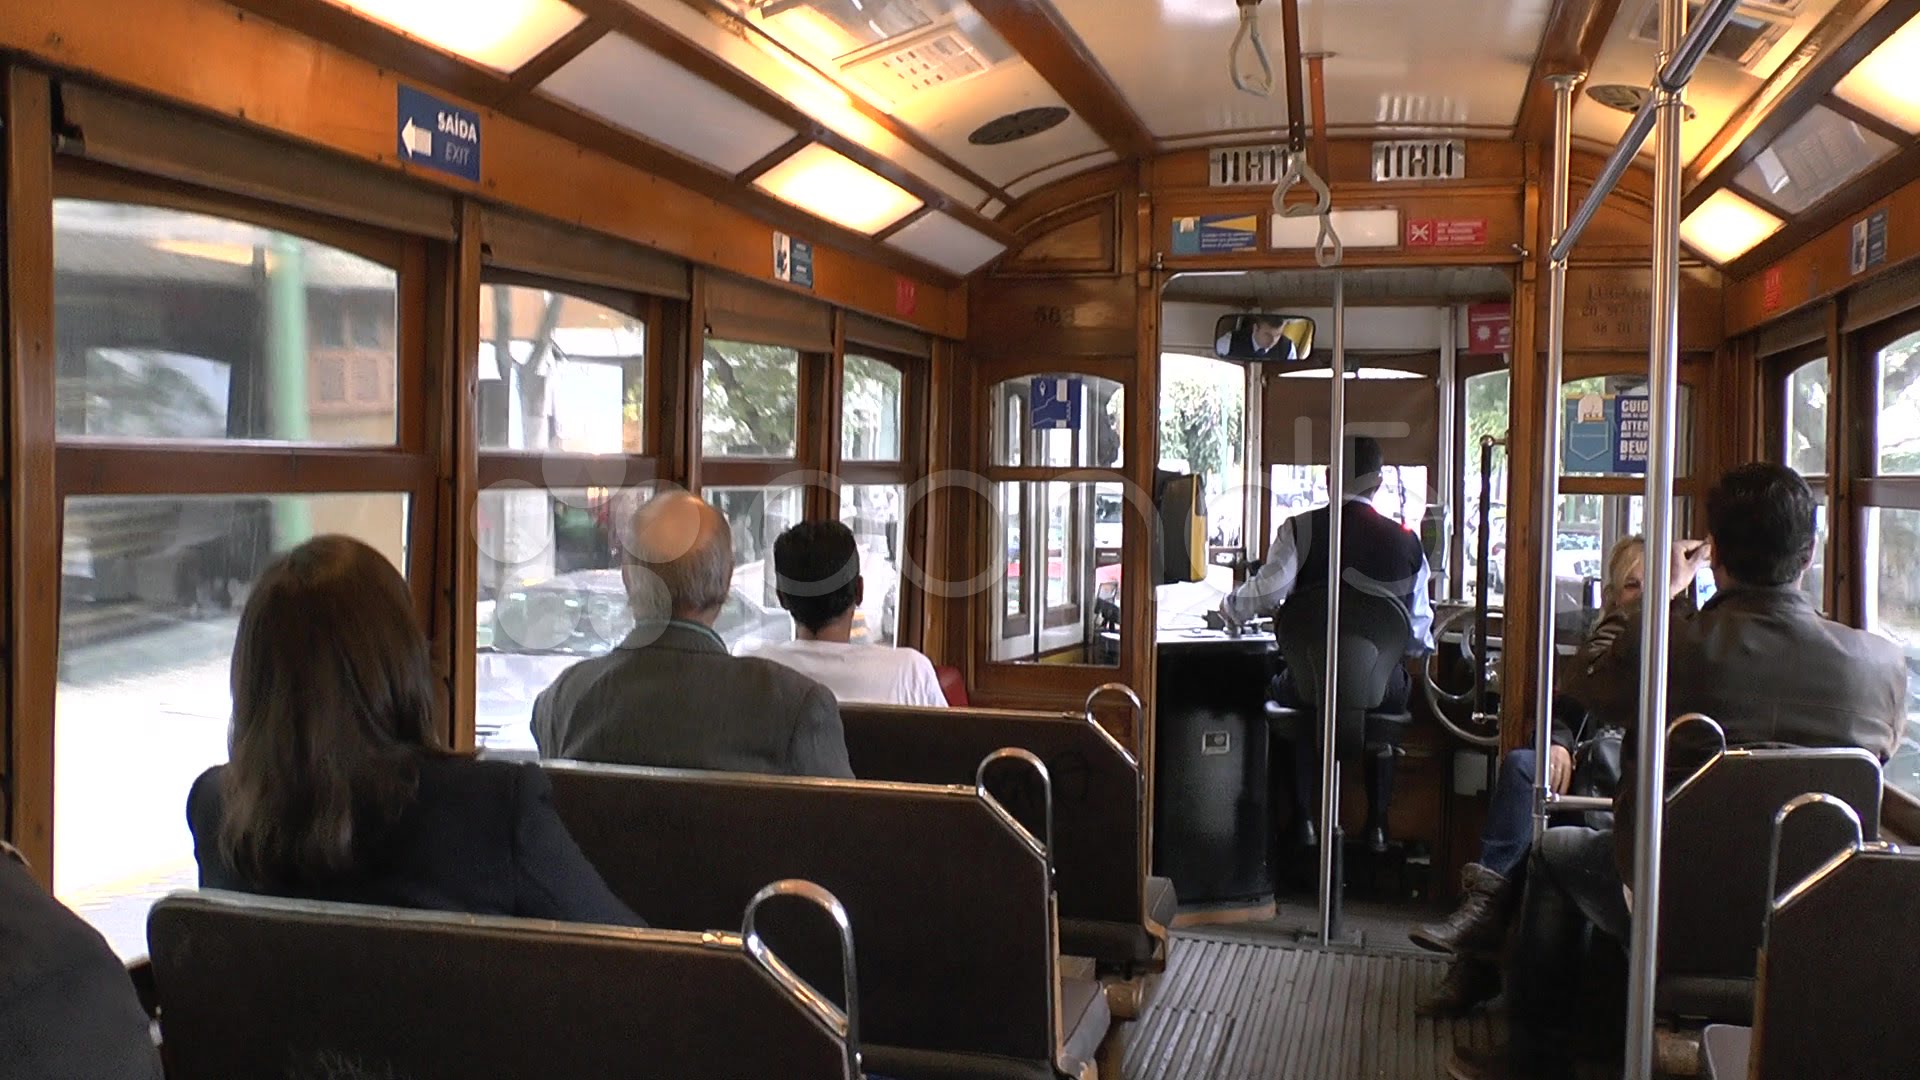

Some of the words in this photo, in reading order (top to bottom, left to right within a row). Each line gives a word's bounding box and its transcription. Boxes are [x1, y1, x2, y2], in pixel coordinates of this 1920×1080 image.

[438, 111, 477, 144] SAÍDA
[445, 141, 469, 165] EXIT
[1621, 400, 1648, 412] CUID
[1621, 420, 1648, 431] ATTEN
[1620, 440, 1648, 453] BEW
